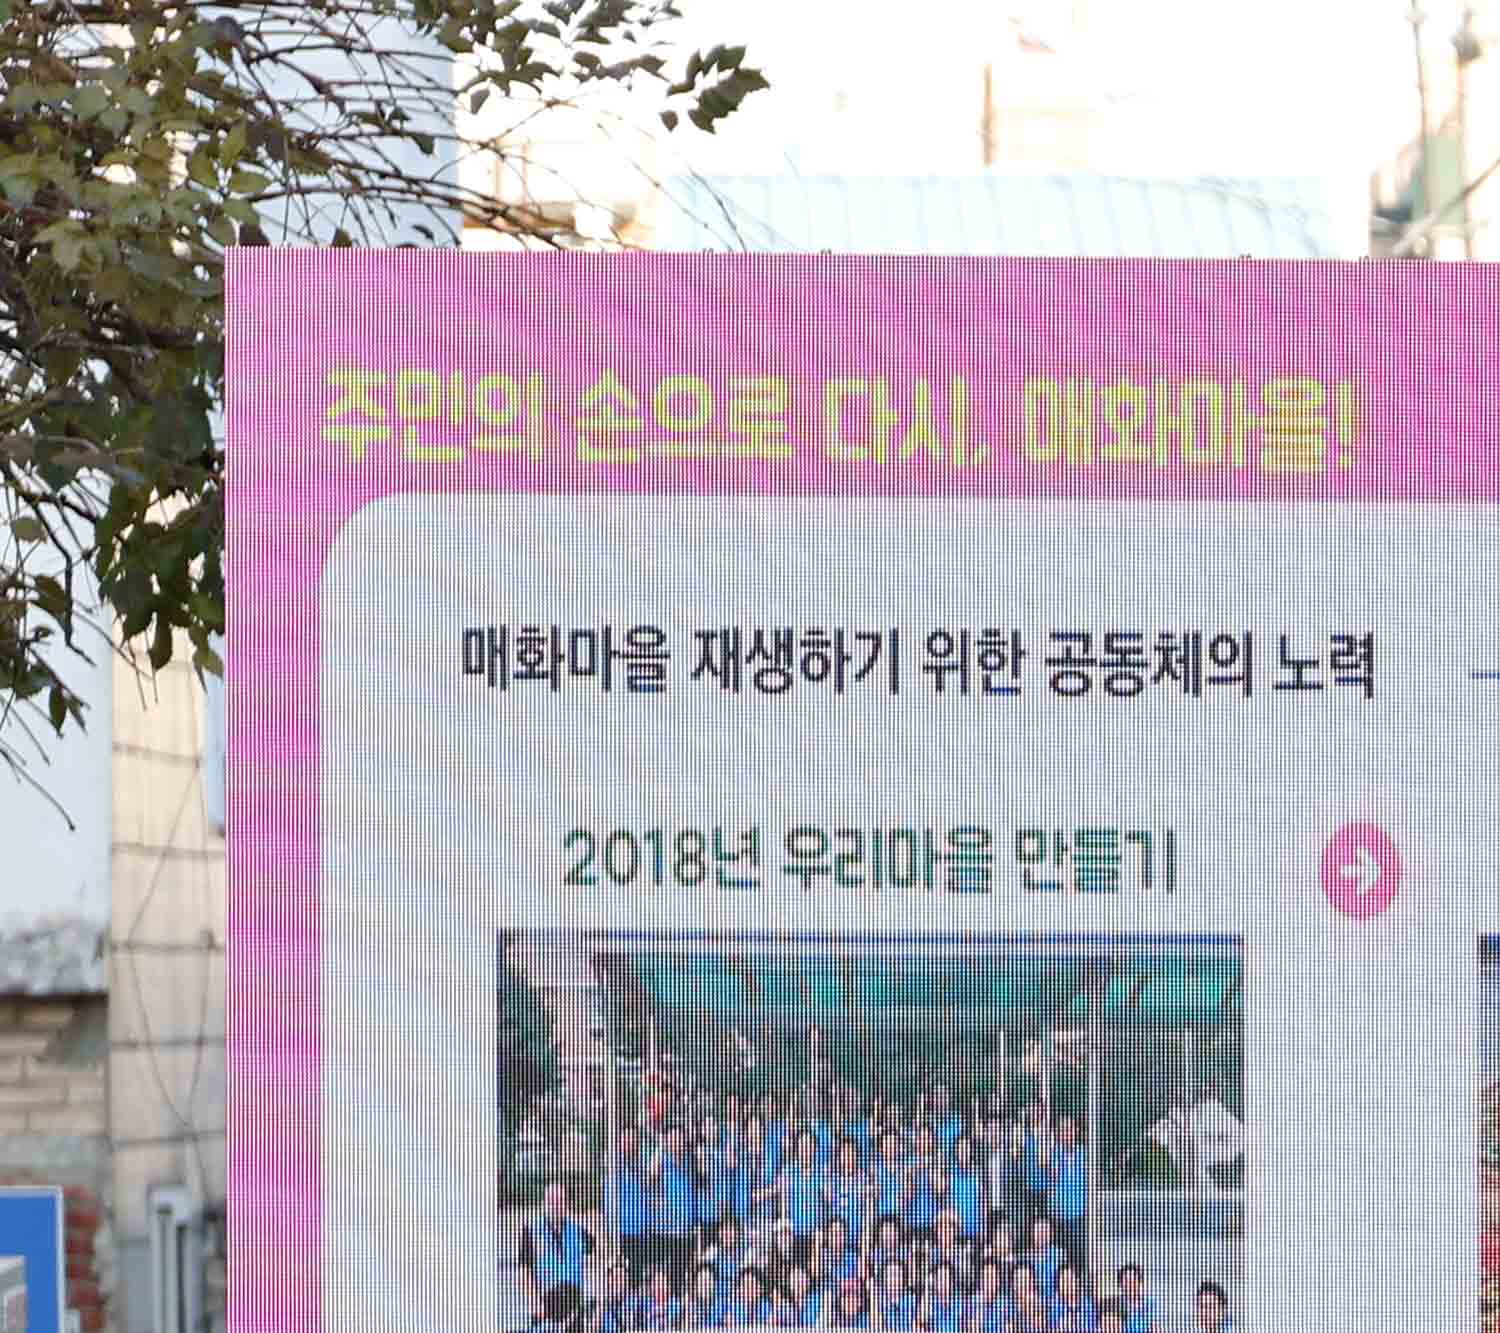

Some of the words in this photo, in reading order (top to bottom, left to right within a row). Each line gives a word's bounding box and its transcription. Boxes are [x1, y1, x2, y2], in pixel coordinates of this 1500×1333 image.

[321, 367, 545, 465] 주민의
[576, 367, 794, 466] 손으로
[823, 373, 992, 468] 다시,
[1023, 374, 1356, 475] 매화마을!
[460, 623, 673, 696] 매화마을
[690, 624, 903, 697] 재생하기
[921, 625, 1026, 698] 위한
[1044, 627, 1253, 700] 공동체의
[1272, 629, 1379, 701] 노력
[562, 826, 763, 890] 2018년
[781, 826, 994, 894] 우리마을
[1013, 827, 1181, 895] 만들기
